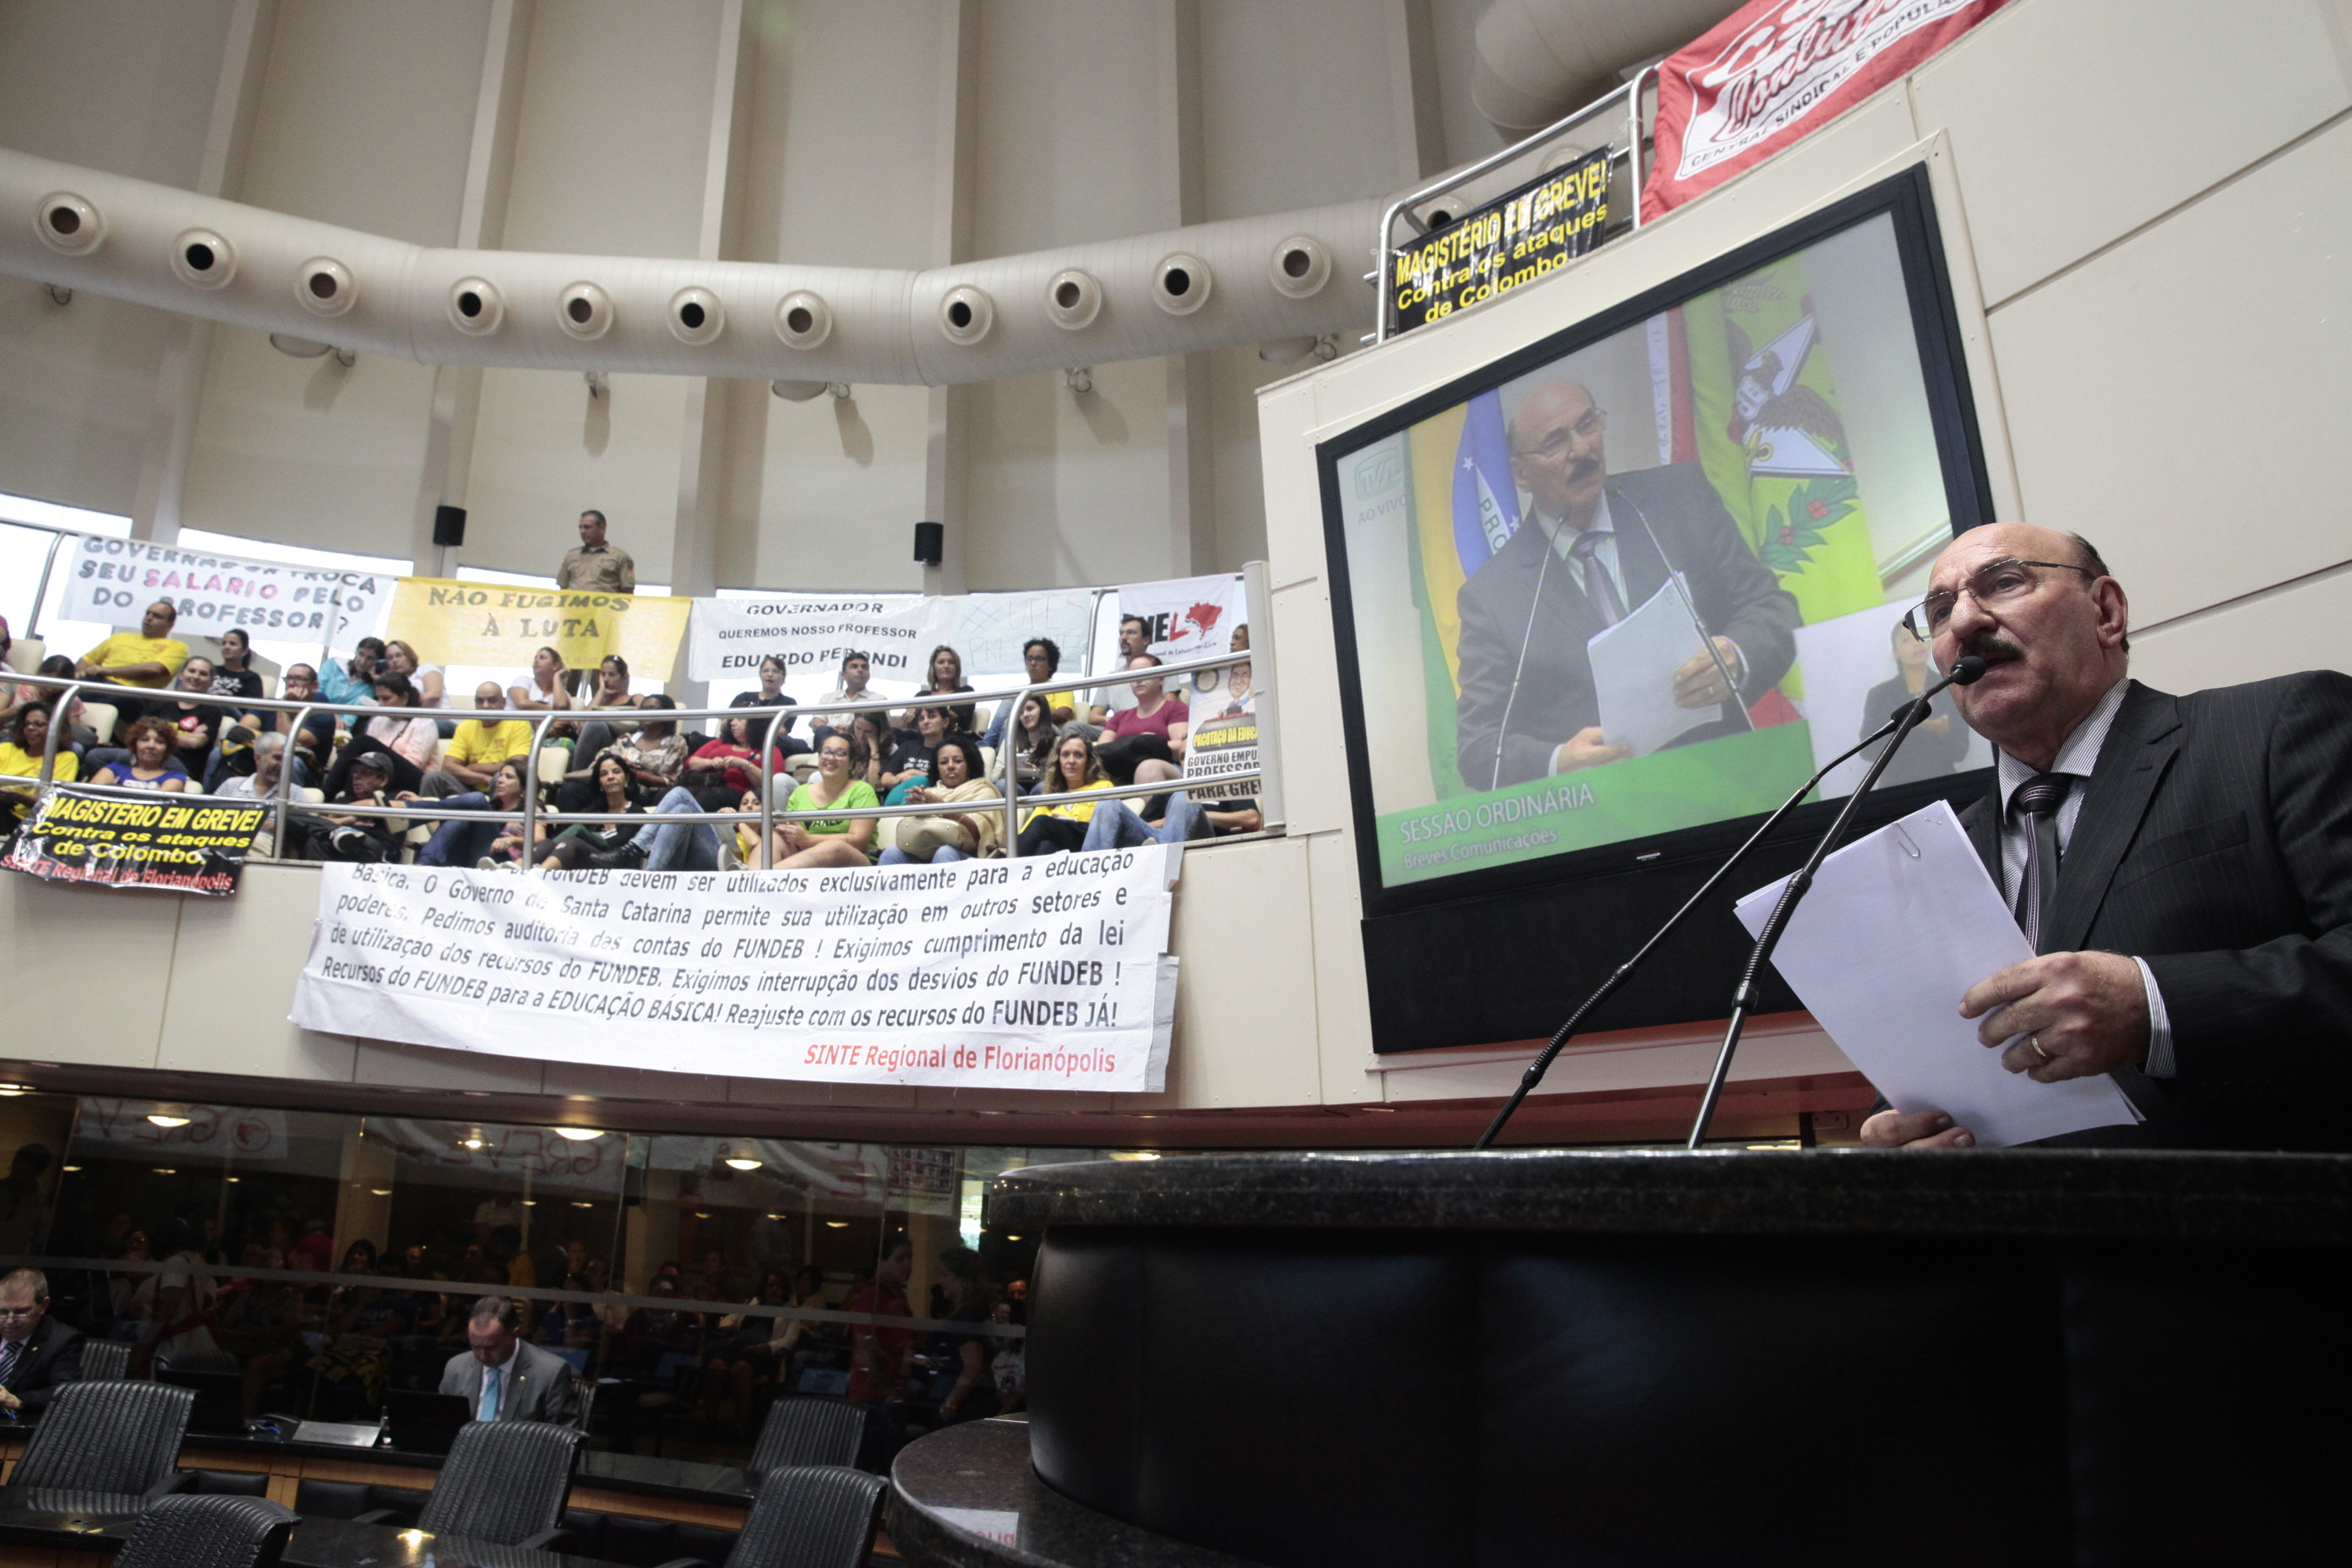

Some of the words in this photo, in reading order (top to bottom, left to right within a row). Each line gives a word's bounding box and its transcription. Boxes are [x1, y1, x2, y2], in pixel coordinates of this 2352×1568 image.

[1690, 125, 1769, 168] CENTRAL
[1775, 65, 1852, 126] SINDICAL
[1855, 49, 1868, 63] E
[1396, 212, 1501, 287] MAGISTÉRIO
[1504, 191, 1533, 237] EM
[1535, 160, 1608, 221] GREVE!
[1397, 267, 1471, 310] Contra
[1478, 253, 1505, 274] os
[1513, 204, 1608, 260] ataques
[1425, 301, 1452, 323] de
[1358, 508, 1375, 525] AO
[1378, 495, 1407, 515] VIVO
[79, 560, 136, 582] SEU
[292, 585, 365, 612] PELO
[92, 587, 133, 607] DO
[428, 585, 487, 606] NÃO
[499, 591, 632, 612] FUGIMOS
[747, 602, 883, 615] GOVERNADOR
[520, 618, 600, 638] LUTA
[719, 628, 787, 640] QUEREMOS
[791, 625, 835, 635] NOSSO
[837, 623, 917, 640] PROFESSOR
[1123, 612, 1190, 644] NEL
[1228, 727, 1239, 743] DA
[1188, 753, 1229, 767] GOVERNO
[159, 807, 193, 830] EM
[192, 808, 264, 831] GREVE!
[1400, 808, 1472, 844] SESSÃO
[1476, 782, 1596, 827] ORDINÁRIA
[32, 822, 116, 841] Contra
[121, 830, 151, 842] os
[156, 833, 251, 848] ataques
[1402, 849, 1448, 870] Breves
[1451, 828, 1558, 862] Comunicações
[53, 840, 84, 856] de
[91, 843, 206, 865] Colombo.
[120, 867, 139, 883] de
[142, 868, 233, 890] Florianópolis
[687, 874, 716, 892] ser
[727, 872, 808, 893] utilizados
[819, 868, 956, 893] exclusivamente
[966, 867, 1009, 890] para
[1021, 864, 1033, 881] a
[1045, 847, 1134, 879] educação
[424, 874, 438, 894] O
[449, 879, 514, 906] Governo
[559, 896, 609, 919] Santa
[621, 900, 692, 924] Catarina
[702, 905, 770, 929] permite
[781, 909, 813, 927] sua
[825, 904, 908, 930] utilização
[921, 905, 949, 923] em
[961, 896, 1018, 920] outros
[1031, 888, 1102, 914] setores
[1115, 886, 1128, 905] e
[422, 906, 497, 937] Pedimos
[504, 920, 580, 945] auditoria
[590, 929, 622, 951] das
[633, 935, 690, 957] contas
[700, 939, 723, 959] do
[732, 939, 805, 960] FUNDEB
[833, 937, 912, 963] Exigimos
[923, 928, 1048, 959] cumprimento
[1059, 922, 1083, 946] da
[1098, 919, 1124, 946] lei
[330, 923, 346, 945] de
[439, 943, 473, 966] dos
[477, 951, 553, 977] recursos
[558, 958, 582, 980] do
[587, 961, 662, 988] FUNDEB.
[672, 968, 749, 995] Exigimos
[757, 969, 858, 997] interrupção
[866, 968, 899, 993] dos
[907, 966, 977, 990] desvios
[986, 965, 1009, 988] do
[1018, 961, 1103, 986] FUNDEB
[322, 956, 385, 983] Recursos
[388, 966, 411, 988] do
[413, 970, 487, 1000] FUNDEB
[487, 986, 530, 1006] para
[532, 991, 545, 1007] a
[548, 989, 645, 1021] EDUCAÇÃO
[647, 994, 724, 1023] BÁSICA!
[726, 1004, 804, 1030] Reajuste
[808, 1010, 846, 1026] com
[851, 1010, 871, 1026] os
[876, 1004, 957, 1026] recursos
[961, 1001, 985, 1026] do
[993, 999, 1079, 1026] FUNDEB
[1084, 993, 1118, 1027] JÁ!
[803, 1044, 862, 1066] SINTE
[865, 1044, 946, 1072] Regional
[953, 1044, 977, 1070] de
[983, 1045, 1116, 1077] Florianópolis
